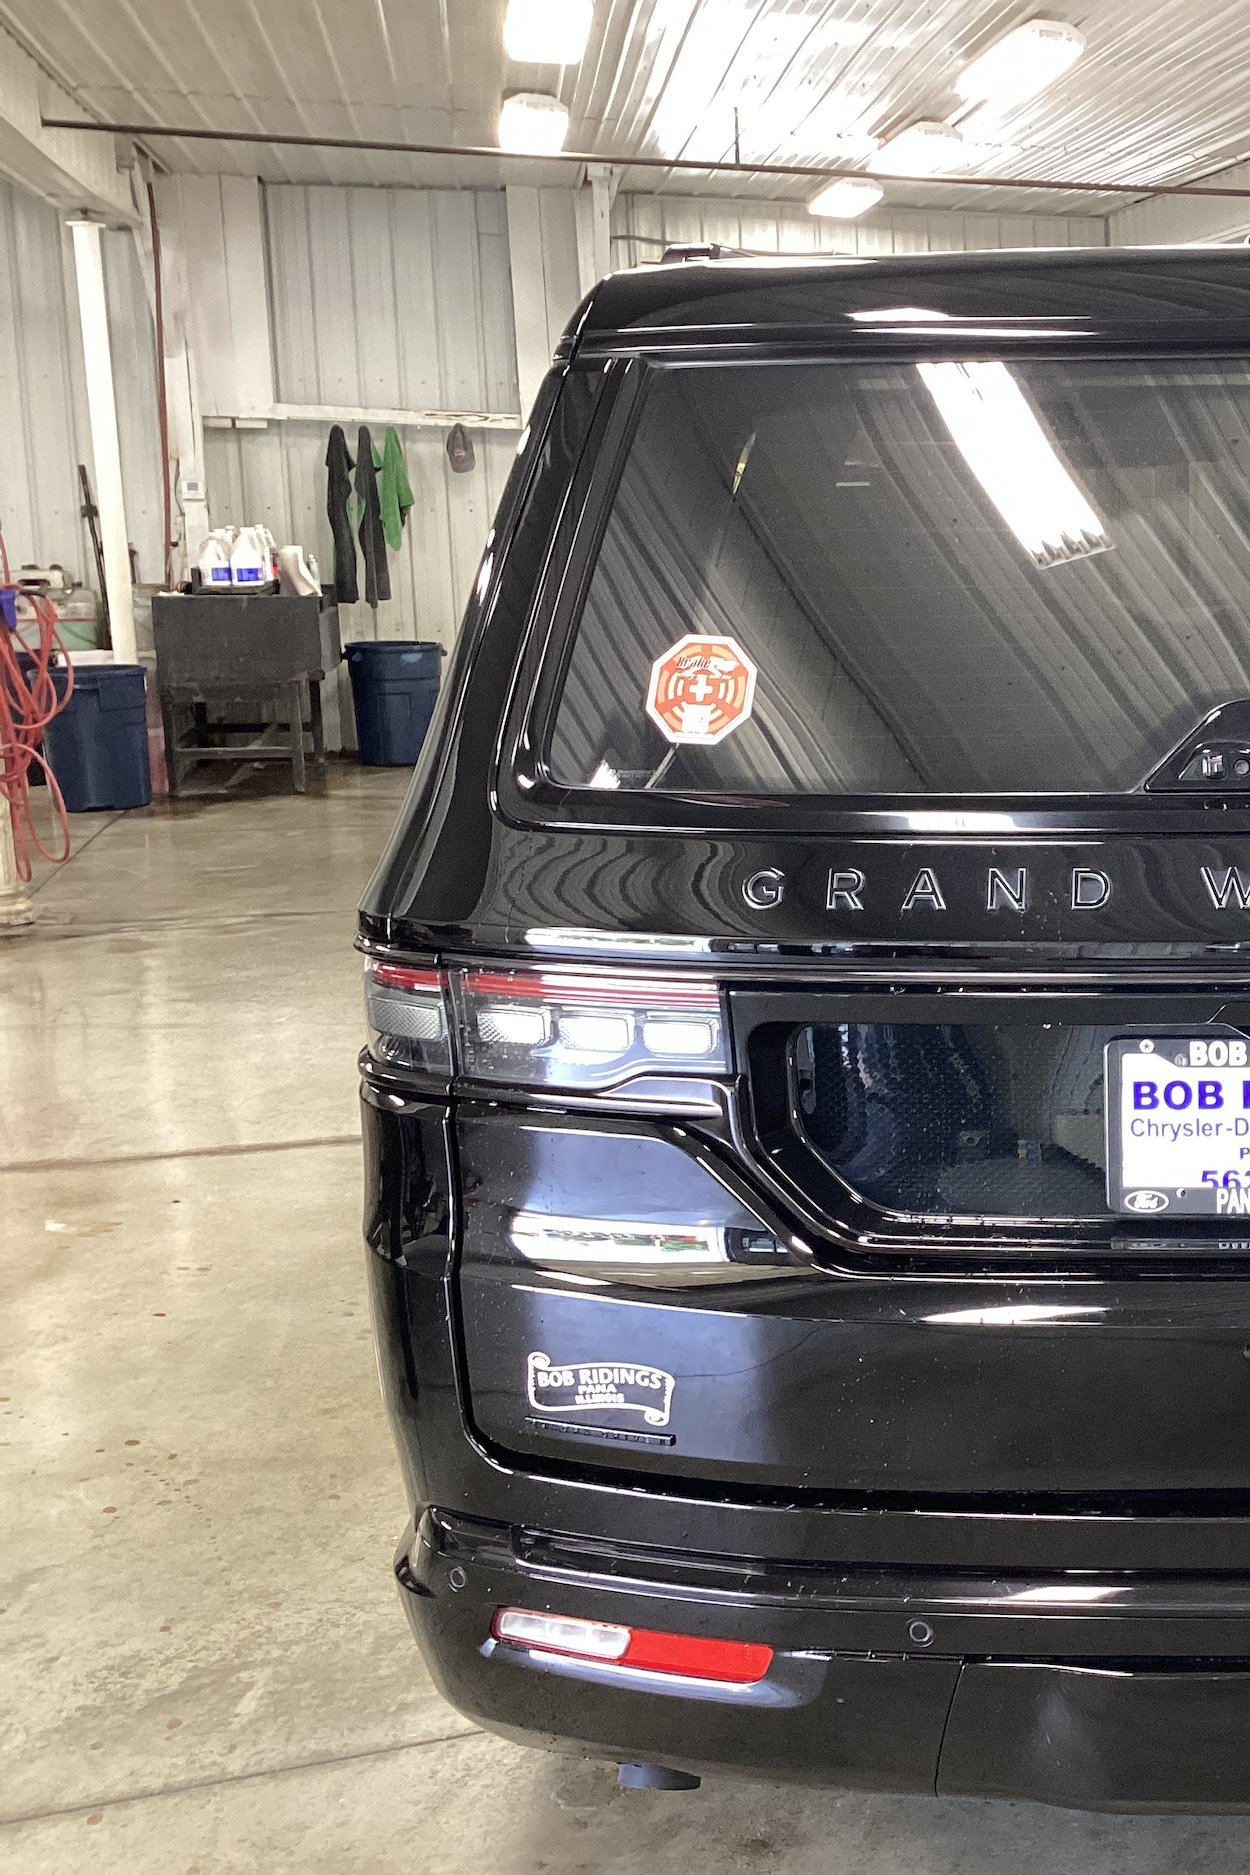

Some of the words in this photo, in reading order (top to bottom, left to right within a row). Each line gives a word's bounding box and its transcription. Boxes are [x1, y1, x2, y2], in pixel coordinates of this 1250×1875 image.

[740, 866, 1111, 912] GRAND
[1189, 1041, 1248, 1067] BOB
[1133, 1080, 1225, 1111] BOB
[537, 1370, 575, 1388] BOB
[579, 1368, 662, 1390] RIDINGS
